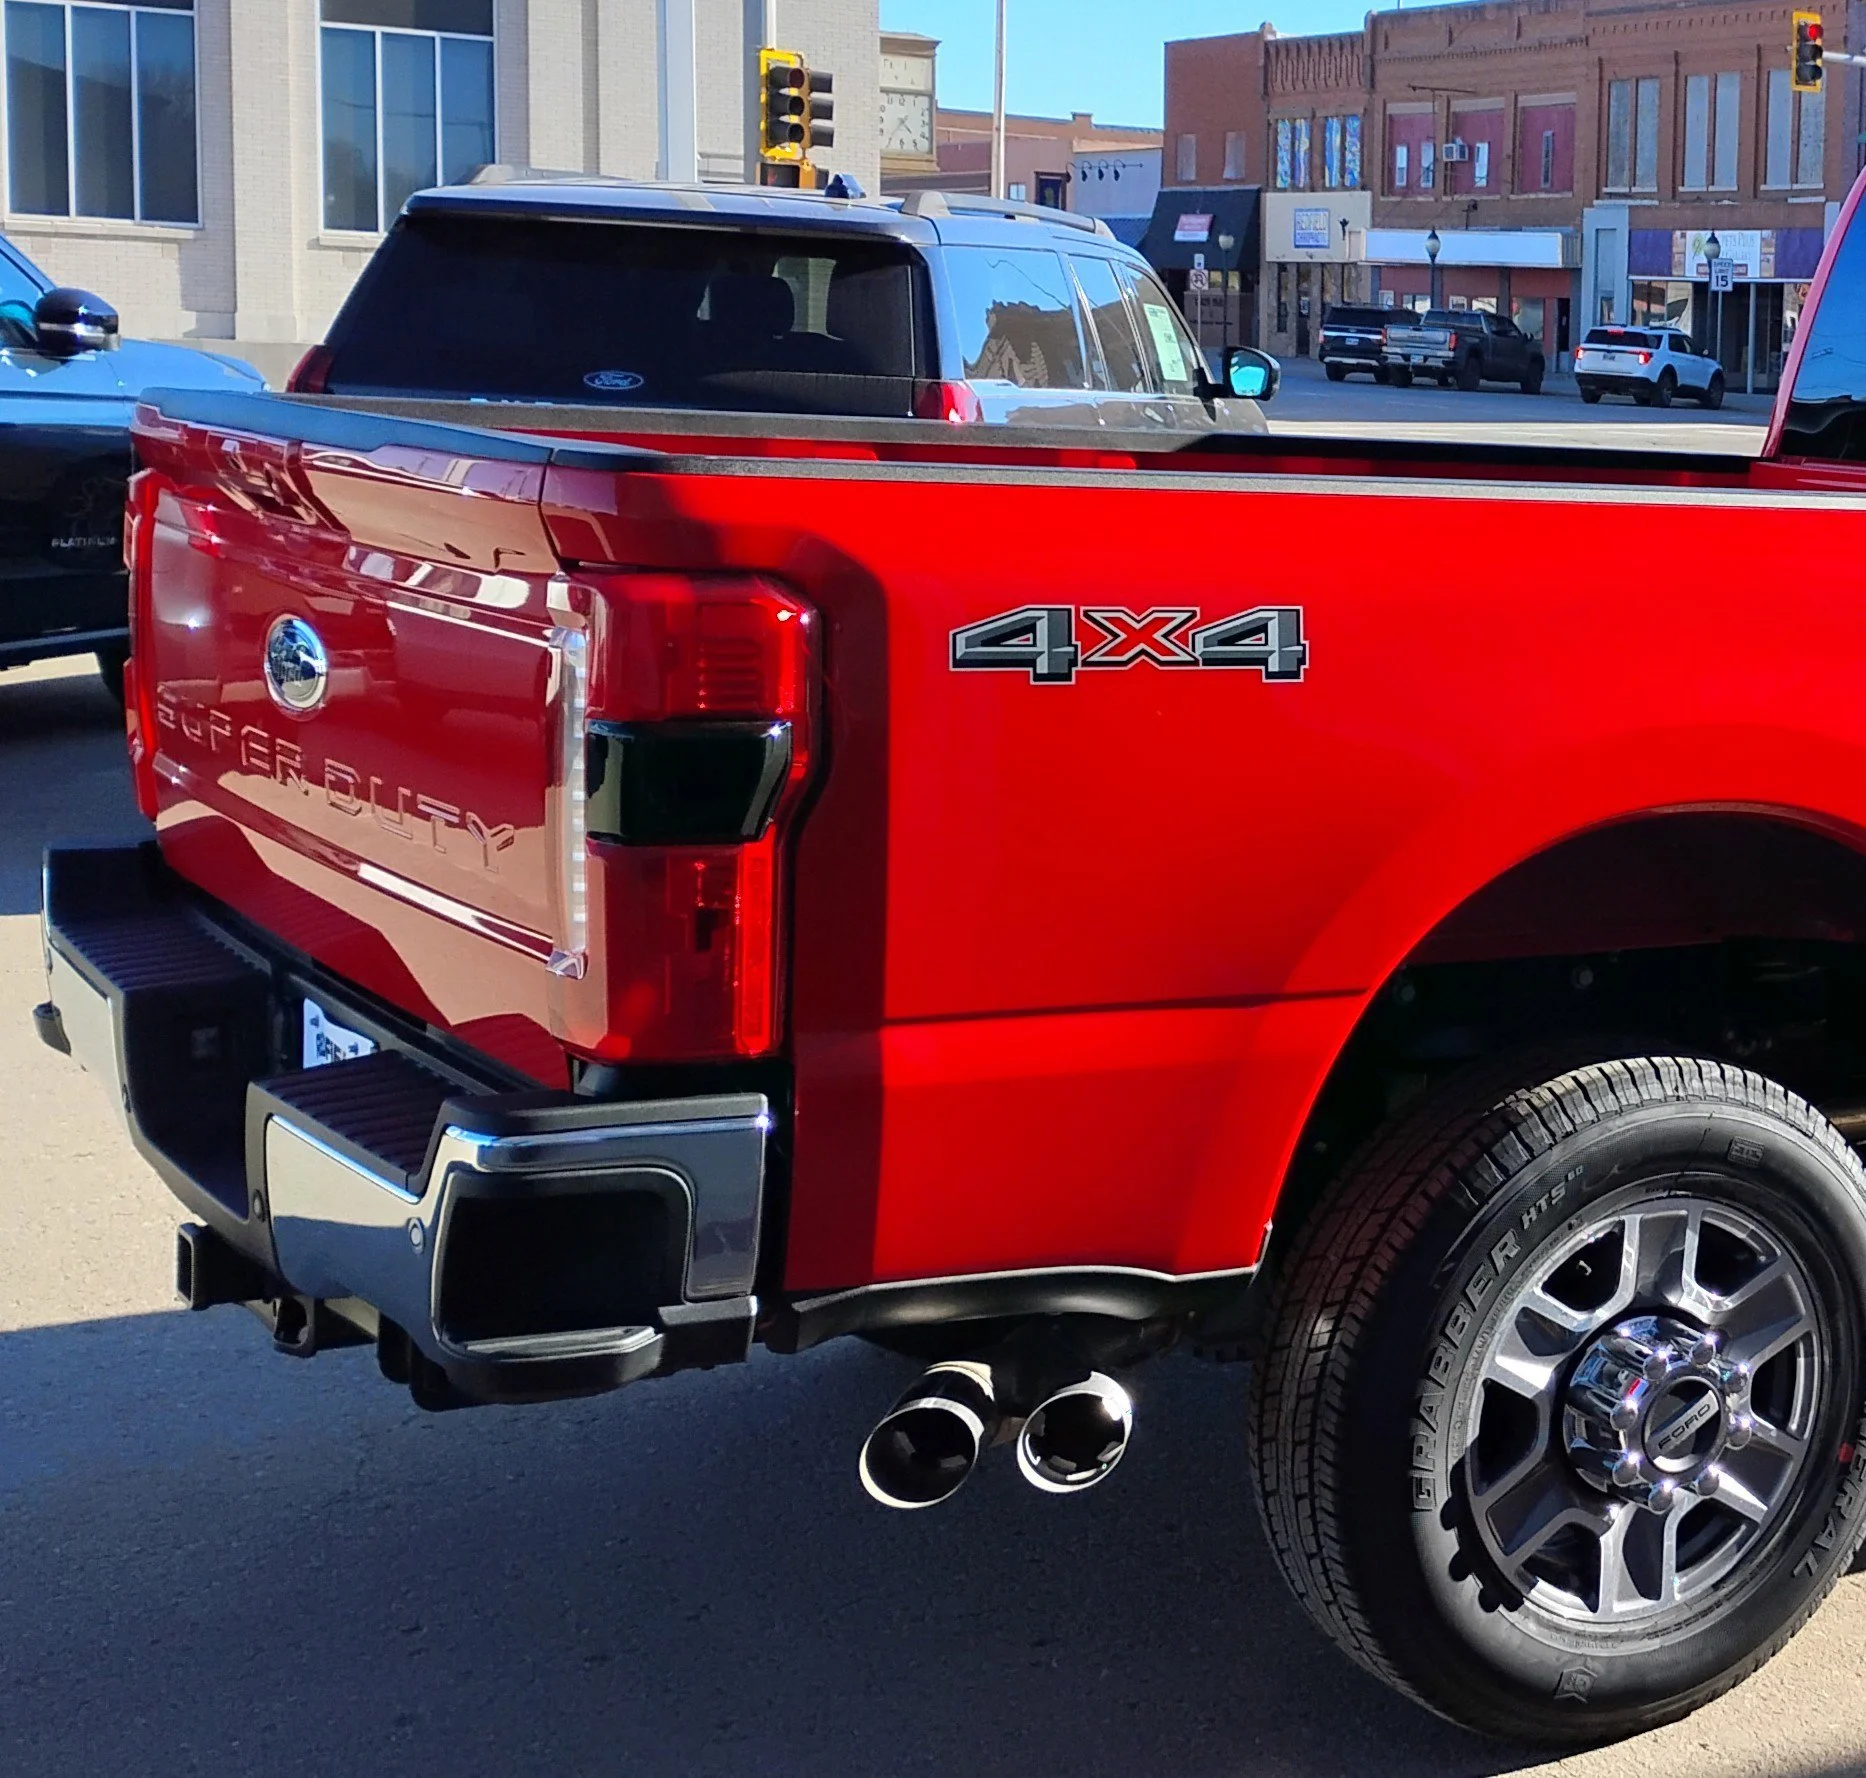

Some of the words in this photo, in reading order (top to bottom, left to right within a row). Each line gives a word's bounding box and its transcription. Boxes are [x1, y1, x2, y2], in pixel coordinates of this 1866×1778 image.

[1716, 275, 1729, 287] 15
[949, 604, 1310, 685] 4X4
[156, 681, 310, 797] SUPER
[323, 757, 516, 874] DUTY
[1411, 1228, 1522, 1512] GRABBER
[1658, 1403, 1711, 1450] FORD
